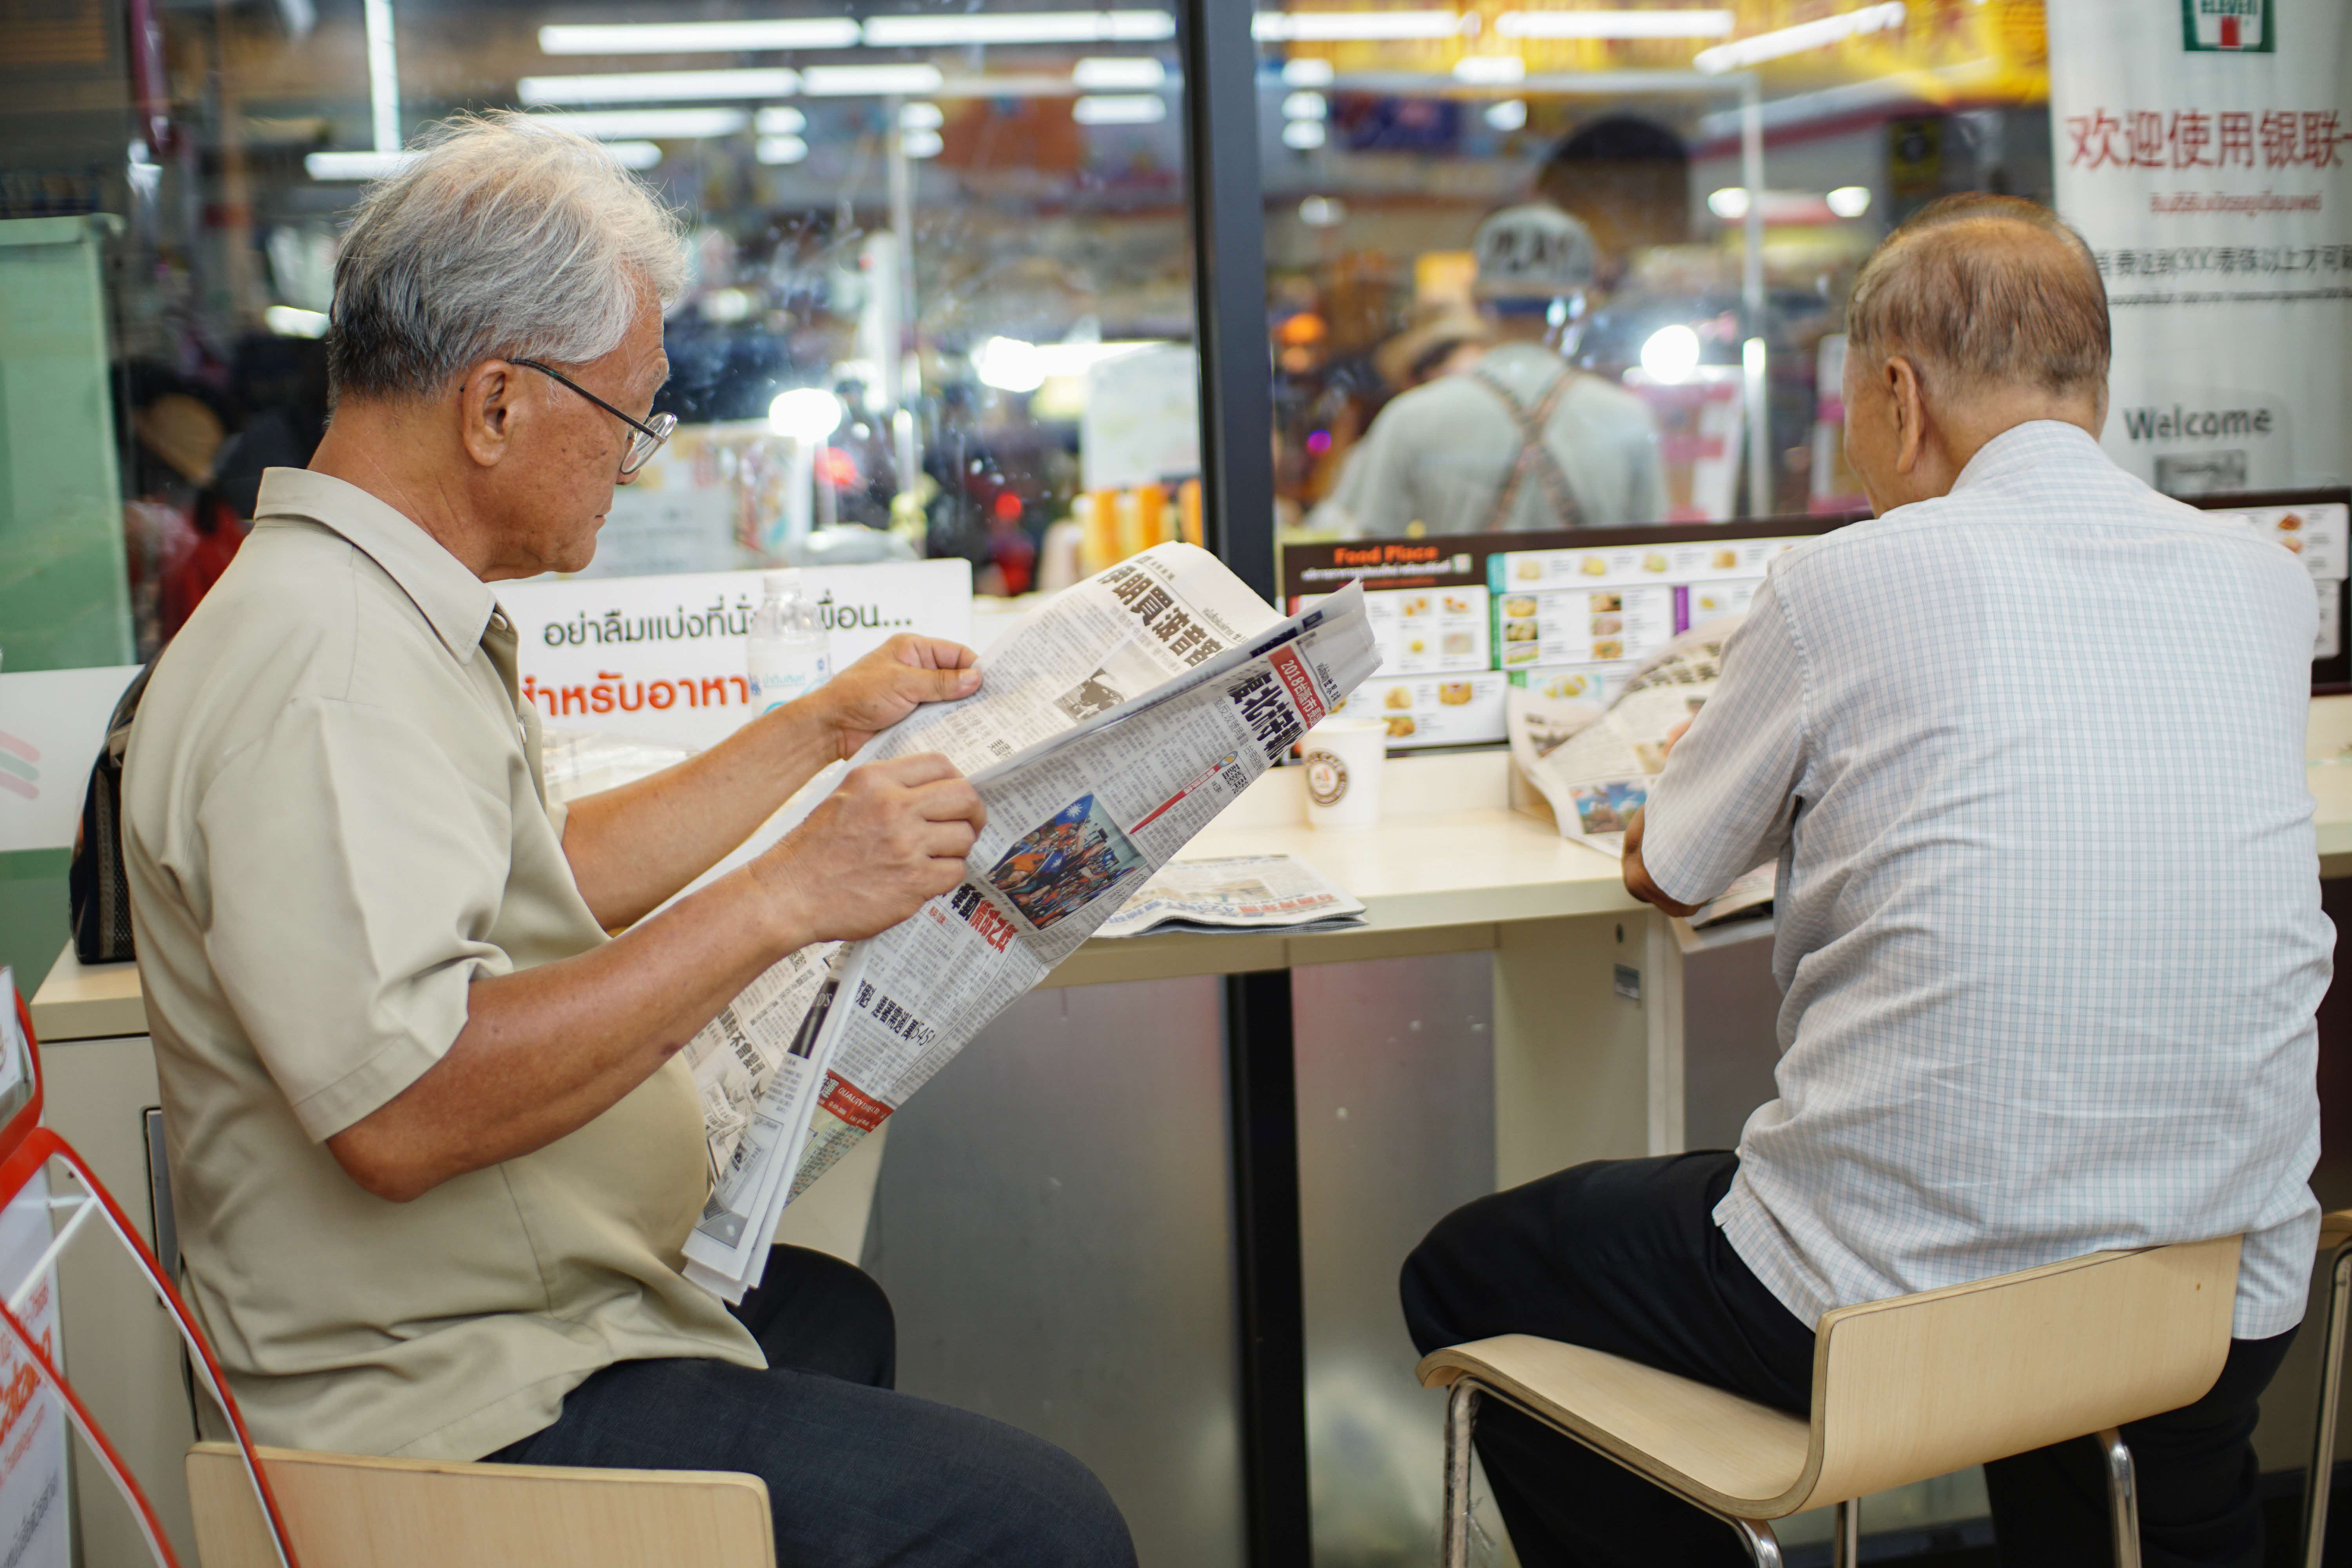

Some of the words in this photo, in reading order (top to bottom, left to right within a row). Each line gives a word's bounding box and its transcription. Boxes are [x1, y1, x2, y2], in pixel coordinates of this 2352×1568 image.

[2065, 108, 2352, 169] 欢迎使用银联
[2123, 403, 2274, 441] Welcome
[1334, 546, 1381, 565] Food
[1384, 545, 1439, 562] Place
[838, 1087, 863, 1107] QUALITY
